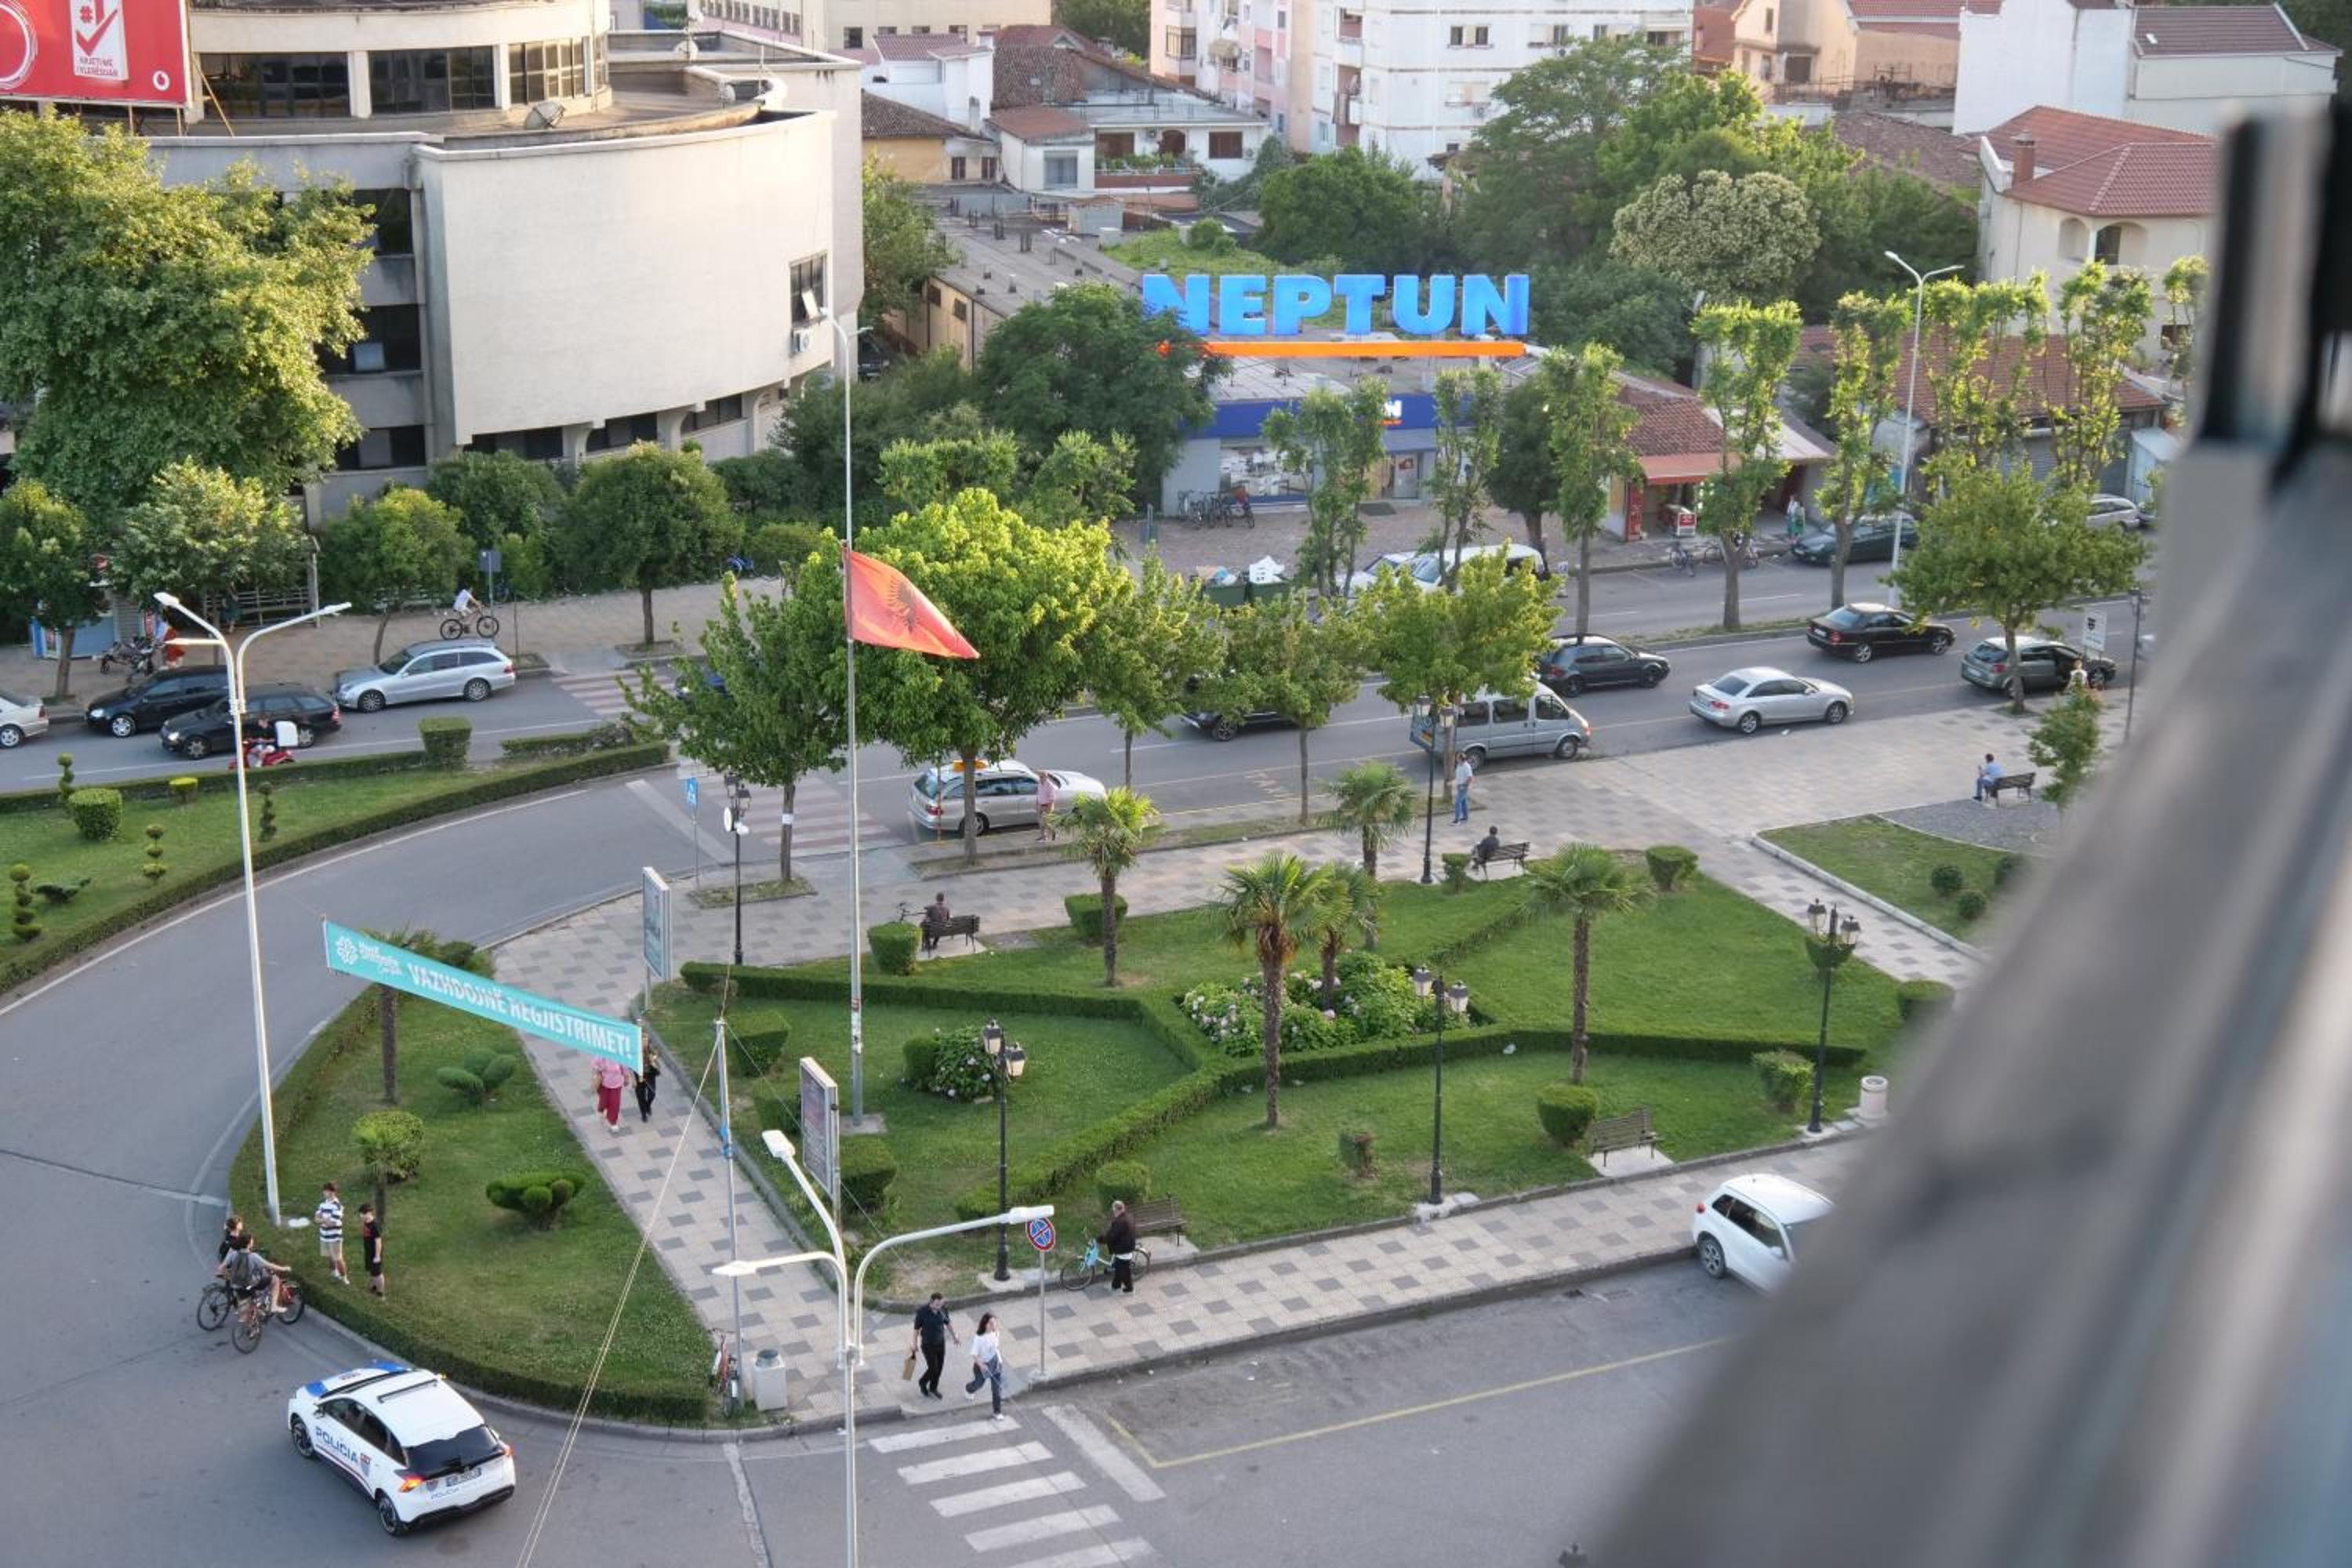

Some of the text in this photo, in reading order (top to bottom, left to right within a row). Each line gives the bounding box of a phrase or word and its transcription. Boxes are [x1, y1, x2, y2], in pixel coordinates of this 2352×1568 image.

[1142, 274, 1530, 336] NEPTUN
[406, 962, 507, 1014] VAZHDOJNË
[315, 1425, 358, 1463] POLICIA
